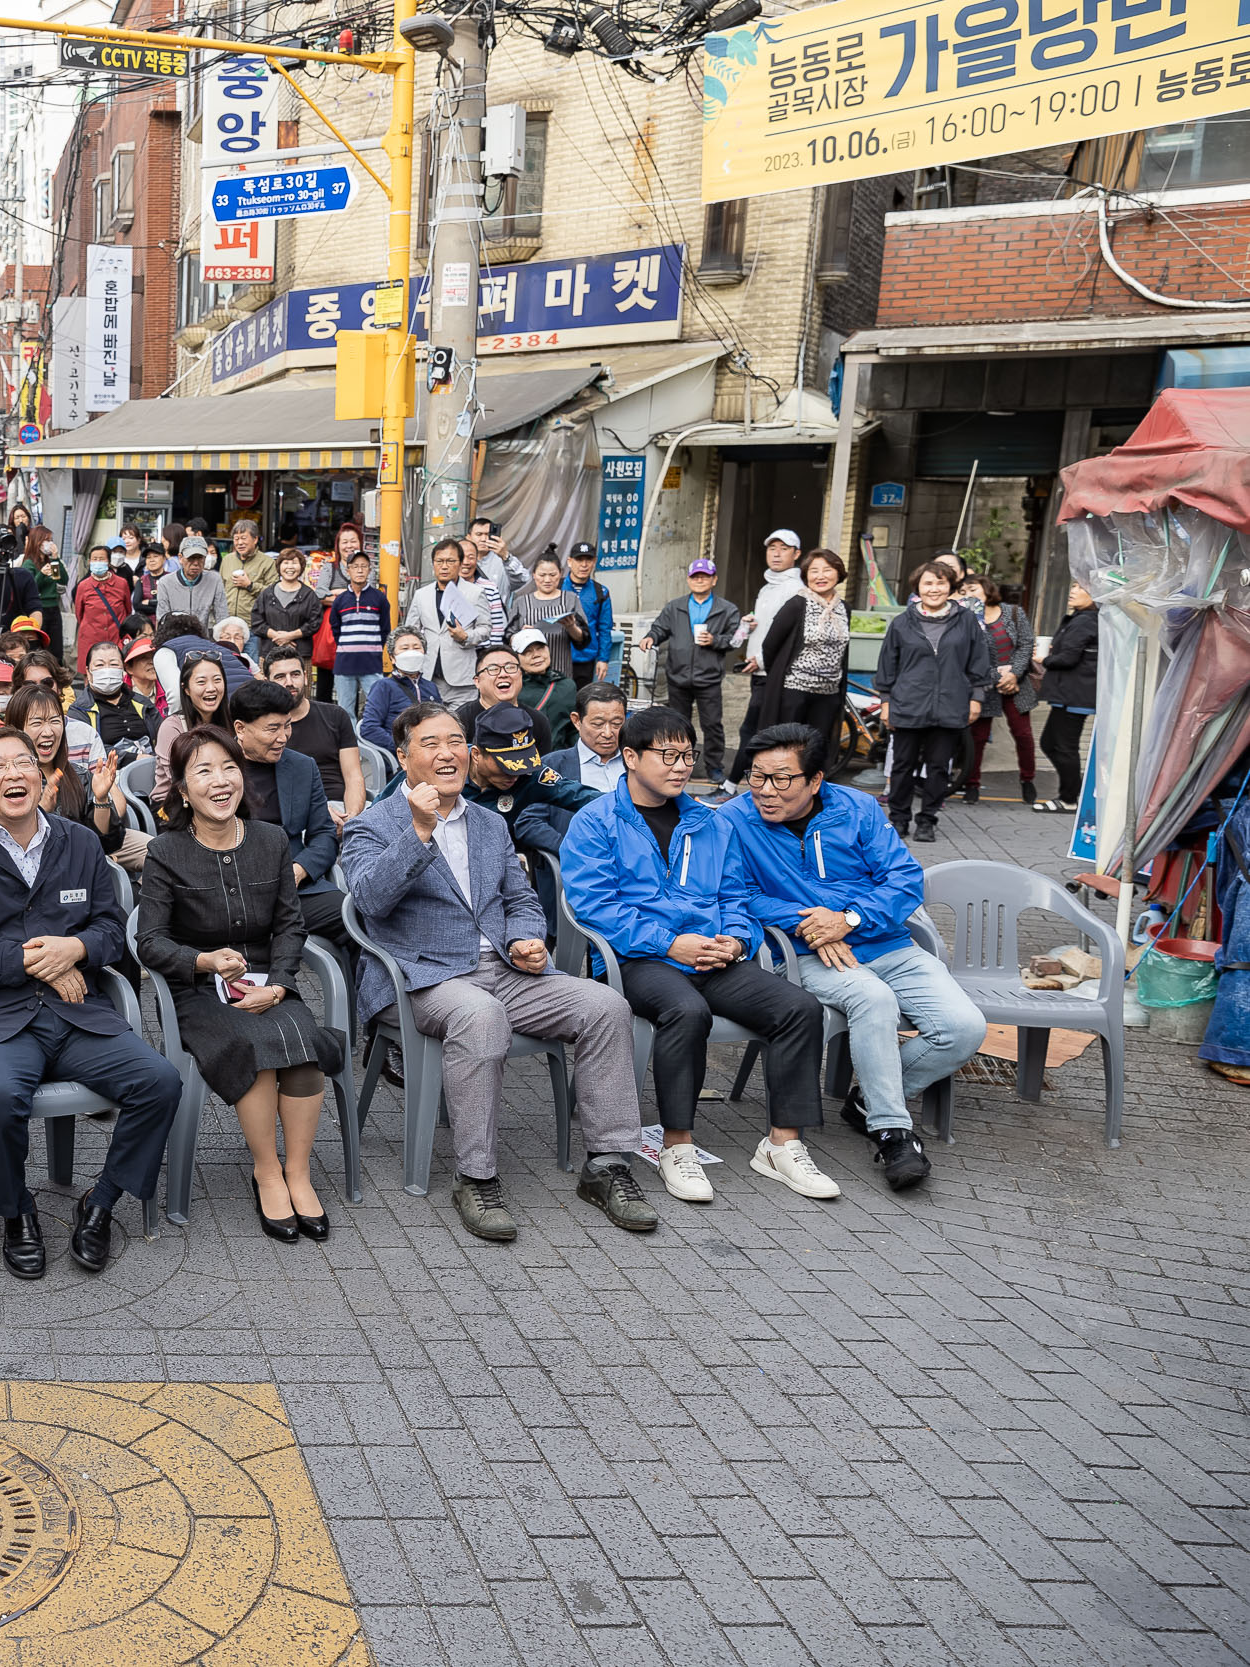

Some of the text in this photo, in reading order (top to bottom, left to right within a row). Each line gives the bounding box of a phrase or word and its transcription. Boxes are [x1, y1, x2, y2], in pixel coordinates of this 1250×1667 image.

[101, 47, 188, 75] CCTV 작동중
[769, 33, 866, 90] 능동로
[767, 76, 869, 124] 골목시장
[764, 152, 804, 173] 2023.
[242, 172, 317, 195] 뚝섬로30길
[331, 182, 346, 195] 37
[216, 195, 229, 206] 33
[237, 188, 325, 207] Ttukseom-ro 30-gil
[205, 267, 271, 280] 463-2384
[103, 280, 118, 329] 혼밥에
[605, 460, 643, 478] 사원모집
[236, 470, 258, 502] 쌀
